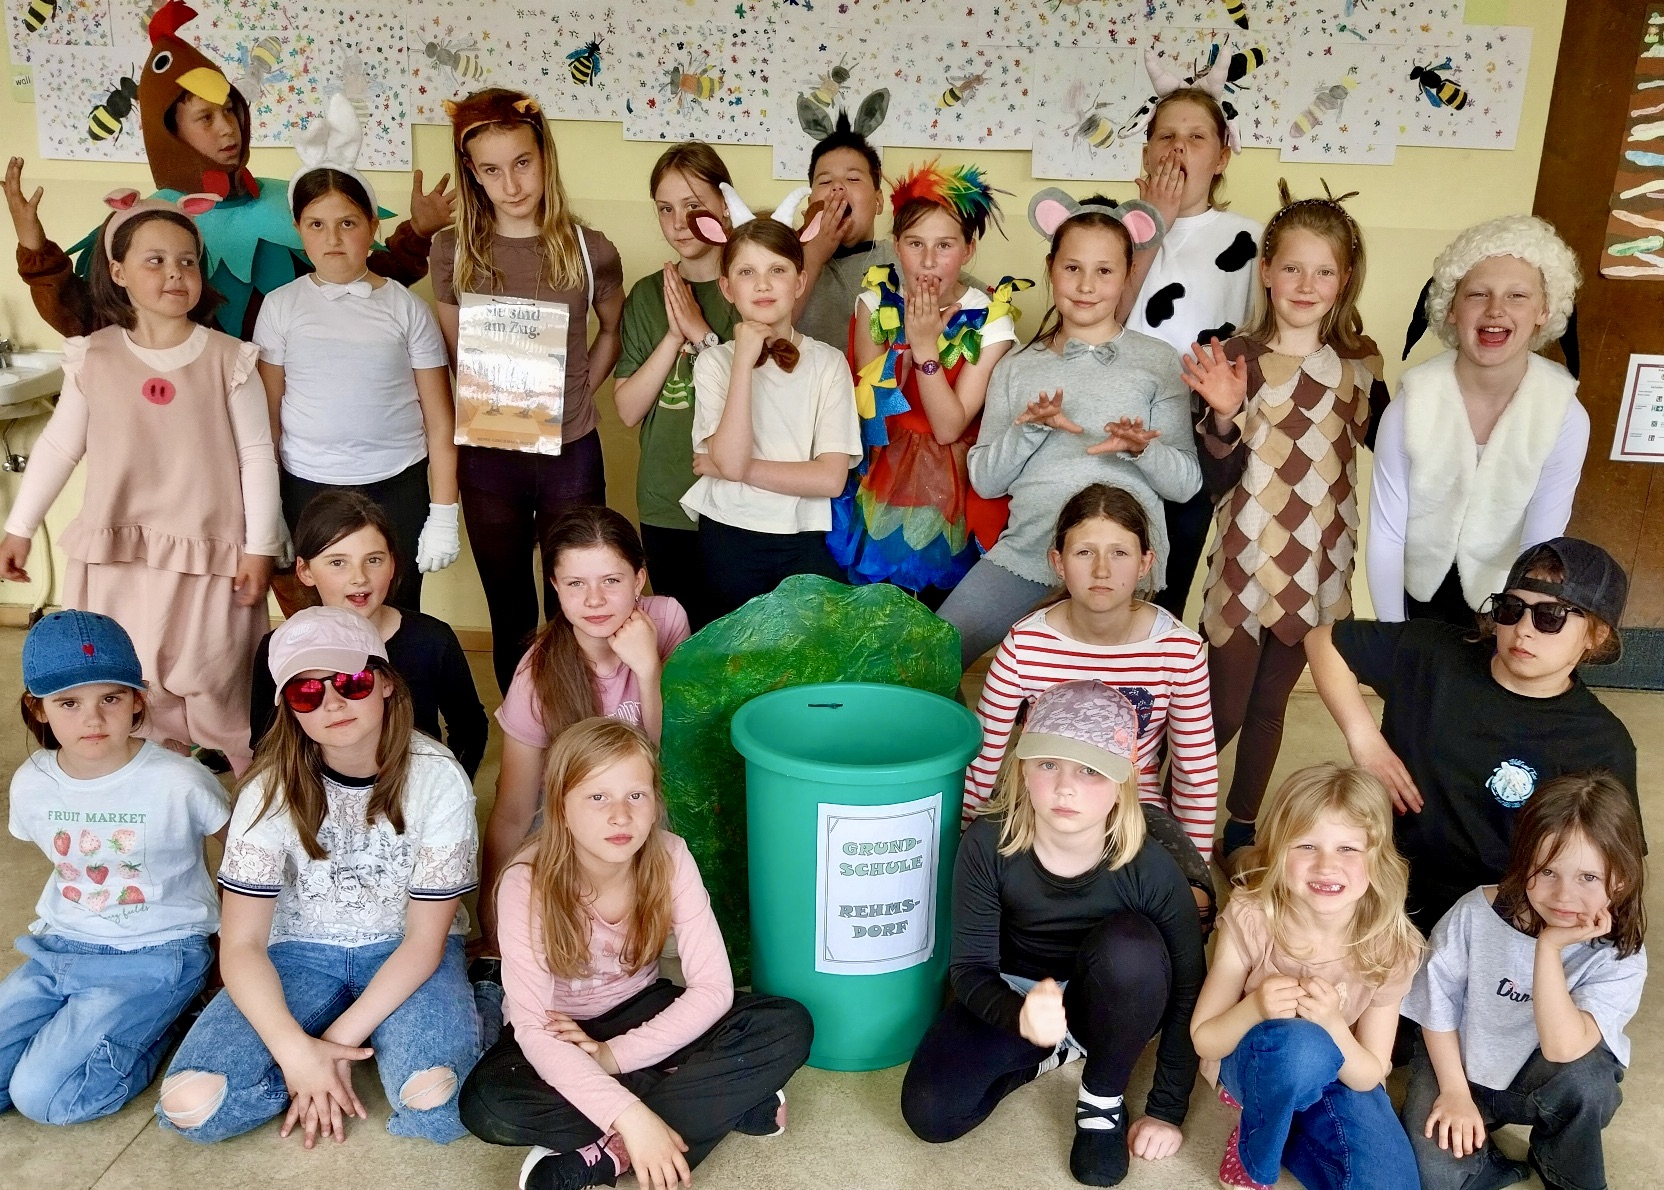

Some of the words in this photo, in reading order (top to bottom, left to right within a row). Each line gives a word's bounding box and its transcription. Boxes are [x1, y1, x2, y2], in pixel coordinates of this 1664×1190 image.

[509, 308, 541, 321] sind
[484, 321, 506, 333] am
[509, 321, 541, 339] Zug.
[48, 810, 80, 822] FRUIT
[85, 812, 146, 824] MARKET
[842, 837, 922, 856] GRUND-
[839, 855, 923, 877] SCHULE
[838, 898, 920, 918] REHMS-
[851, 920, 908, 939] DORF
[1496, 977, 1534, 1003] Dan
